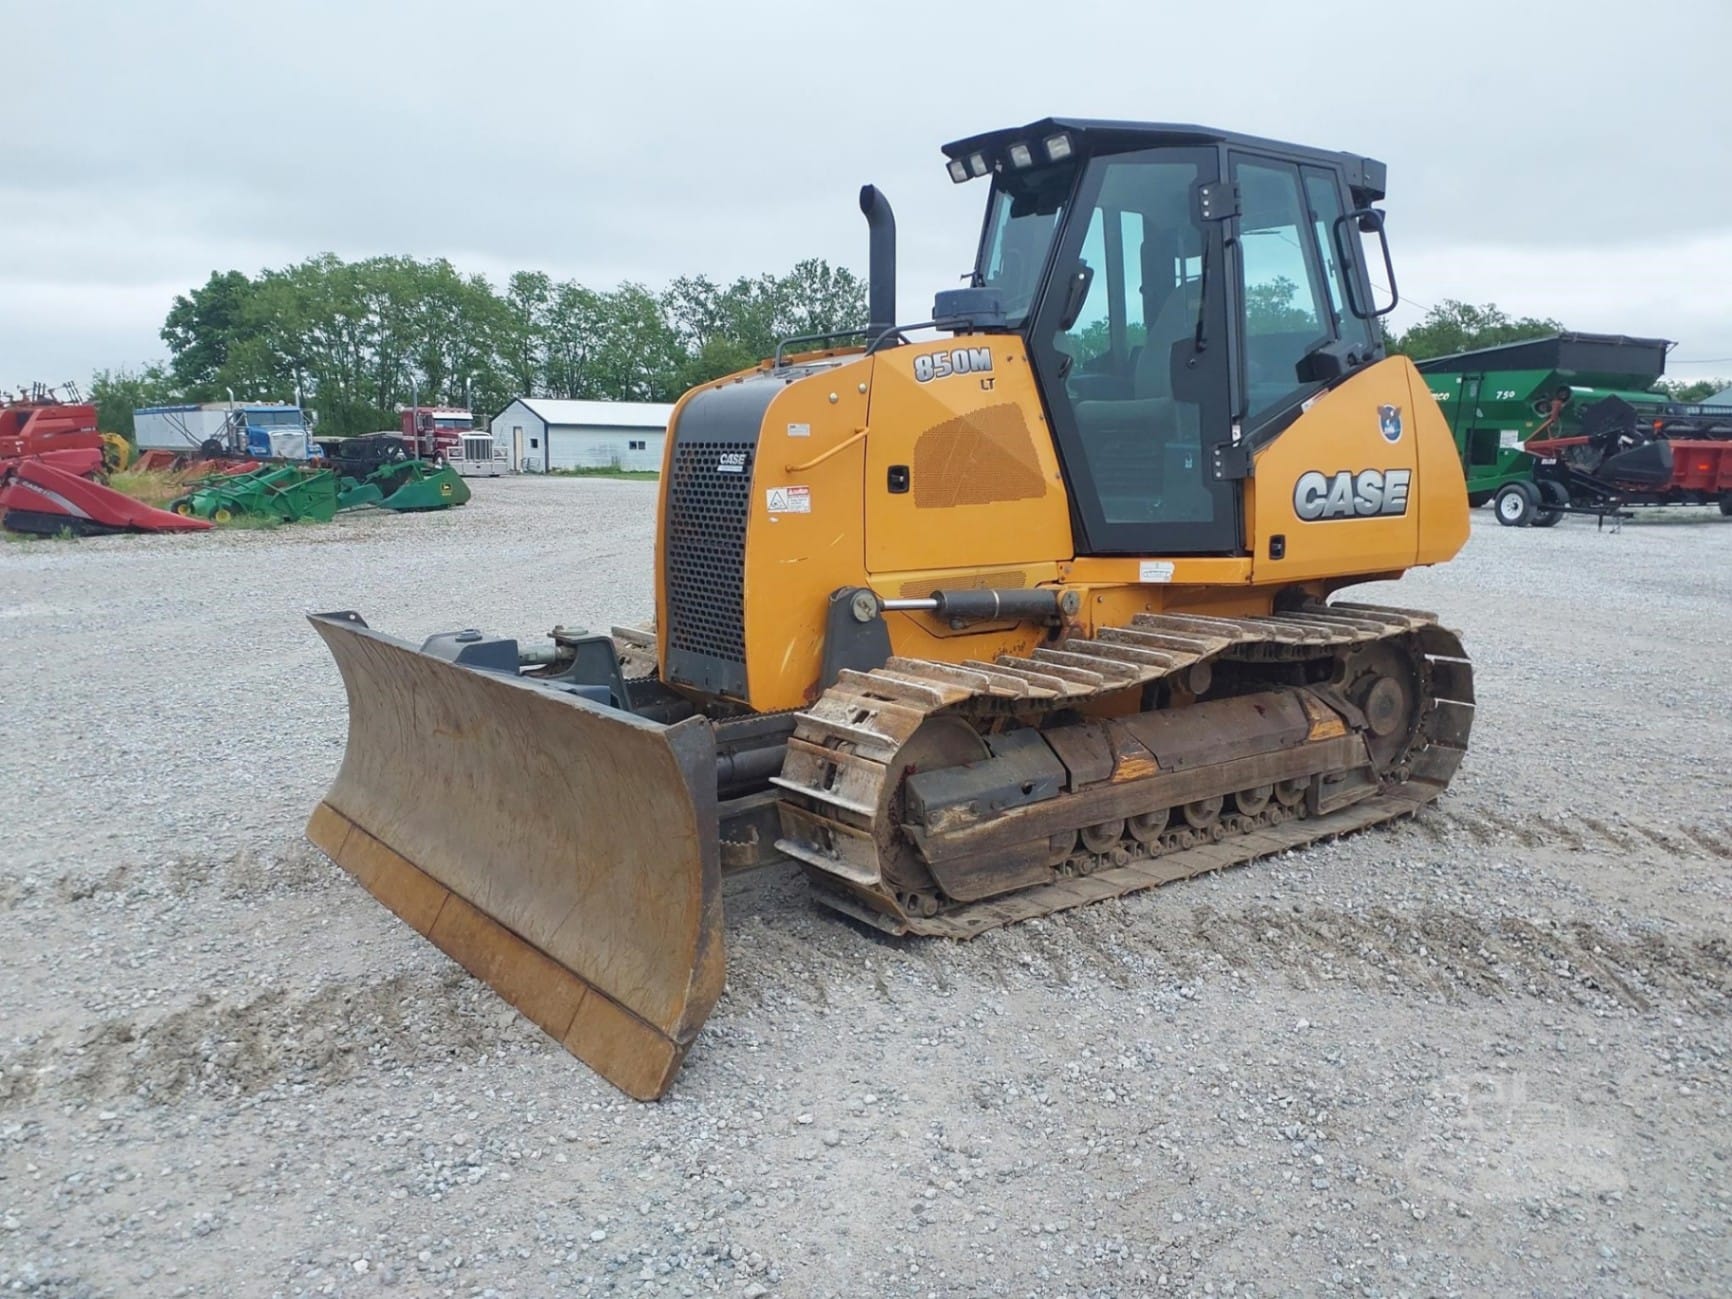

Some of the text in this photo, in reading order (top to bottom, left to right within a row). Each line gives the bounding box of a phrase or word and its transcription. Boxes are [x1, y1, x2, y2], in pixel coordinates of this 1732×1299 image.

[913, 346, 993, 383] 850M
[980, 377, 996, 391] LT
[1496, 390, 1516, 400] 750
[720, 453, 747, 465] CASE
[1292, 467, 1412, 521] CASE
